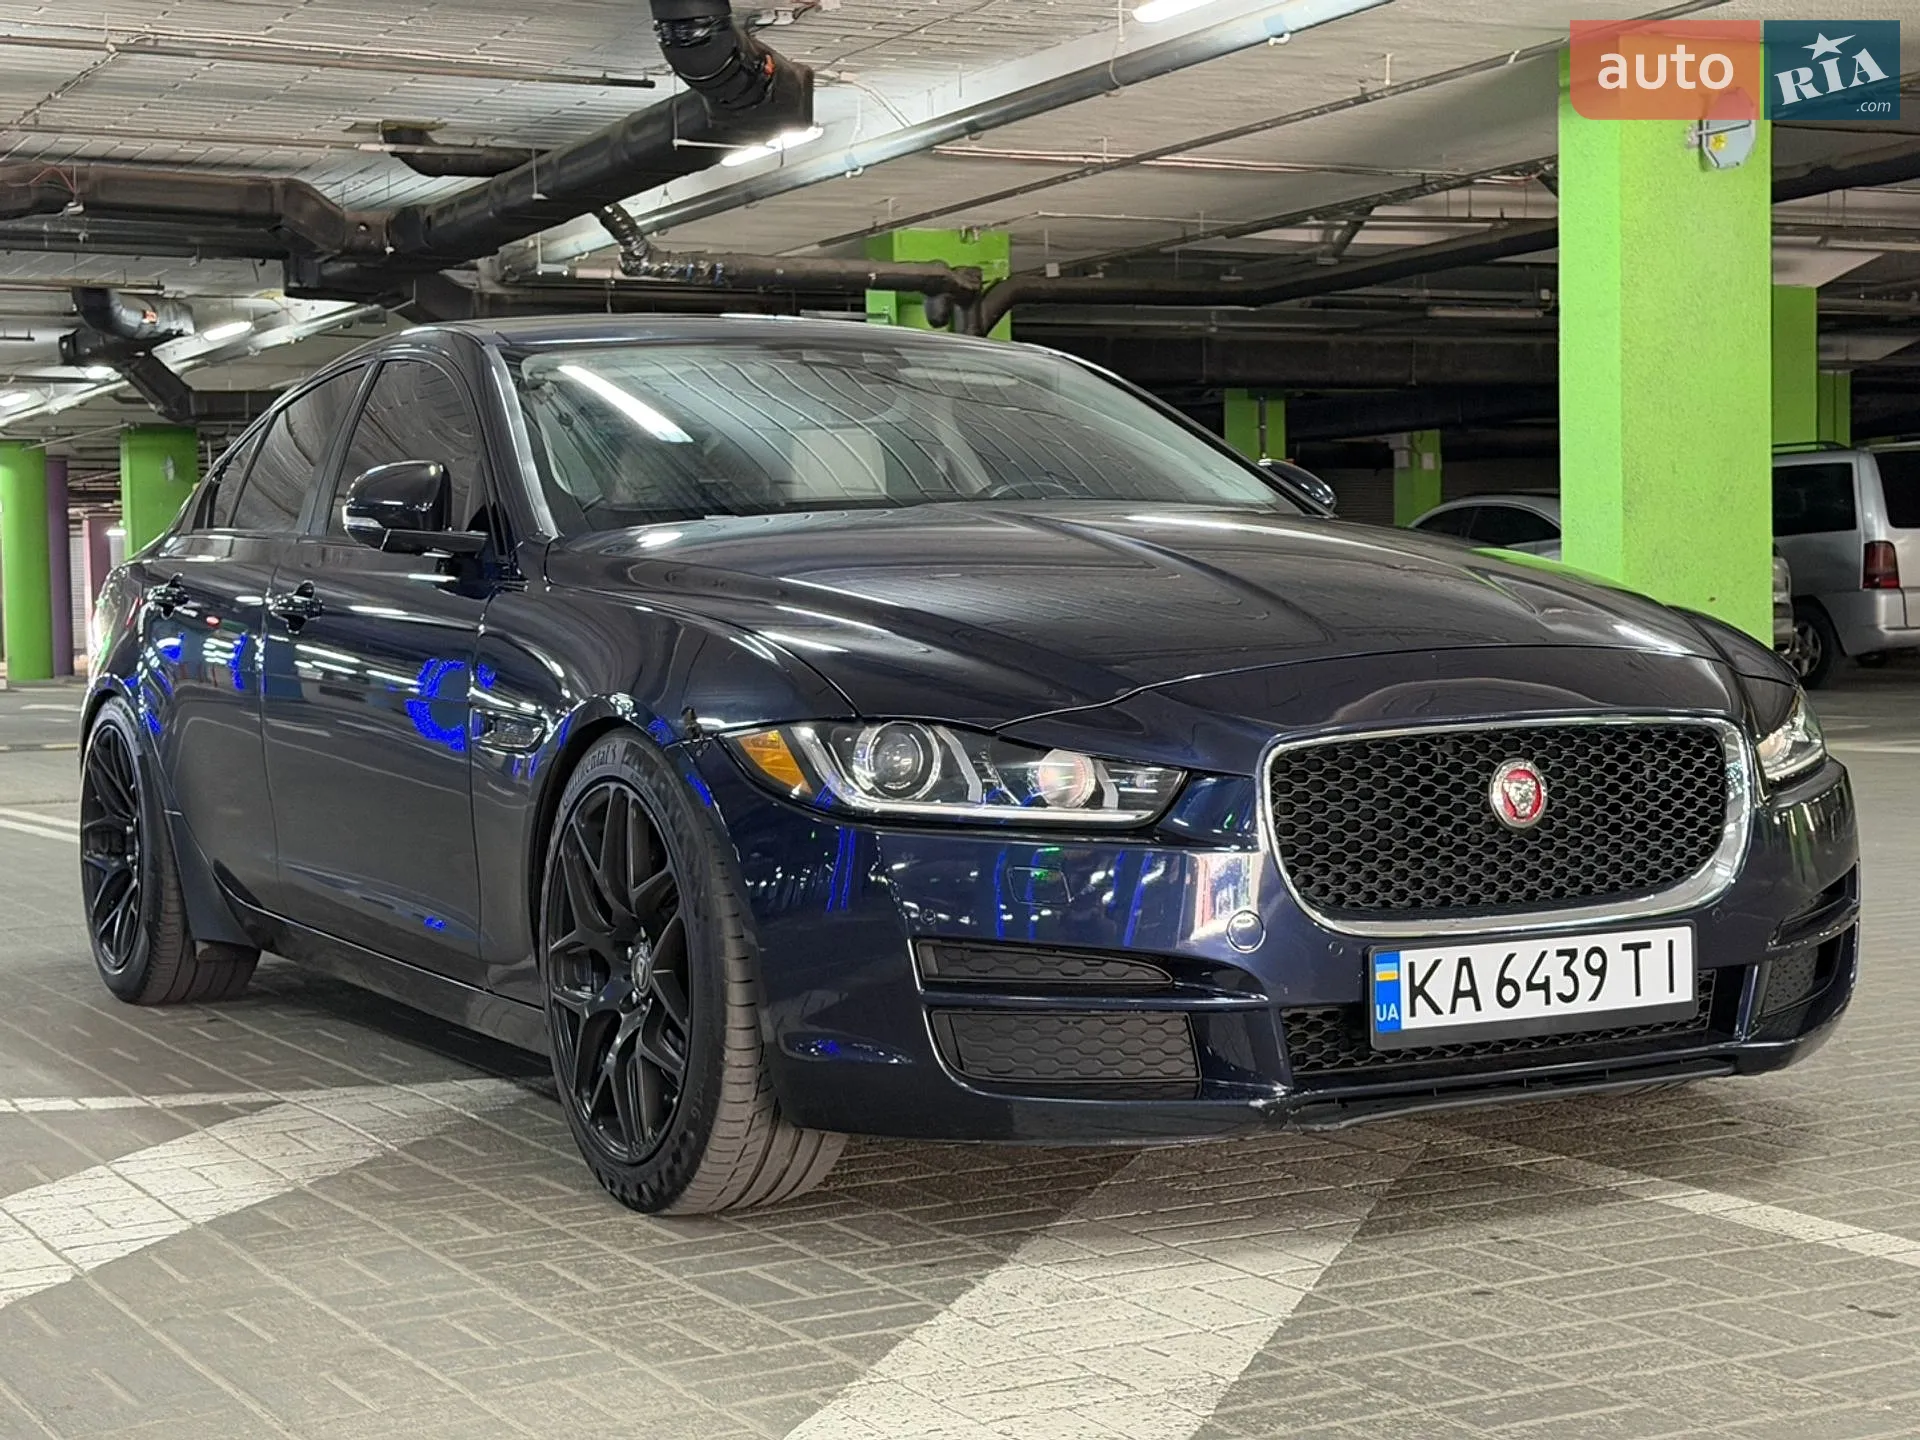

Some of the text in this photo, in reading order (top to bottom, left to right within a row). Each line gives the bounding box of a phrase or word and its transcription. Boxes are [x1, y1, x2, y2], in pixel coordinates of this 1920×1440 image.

[1408, 939, 1675, 1018] KA 6439 TI
[1376, 1004, 1399, 1022] UA
